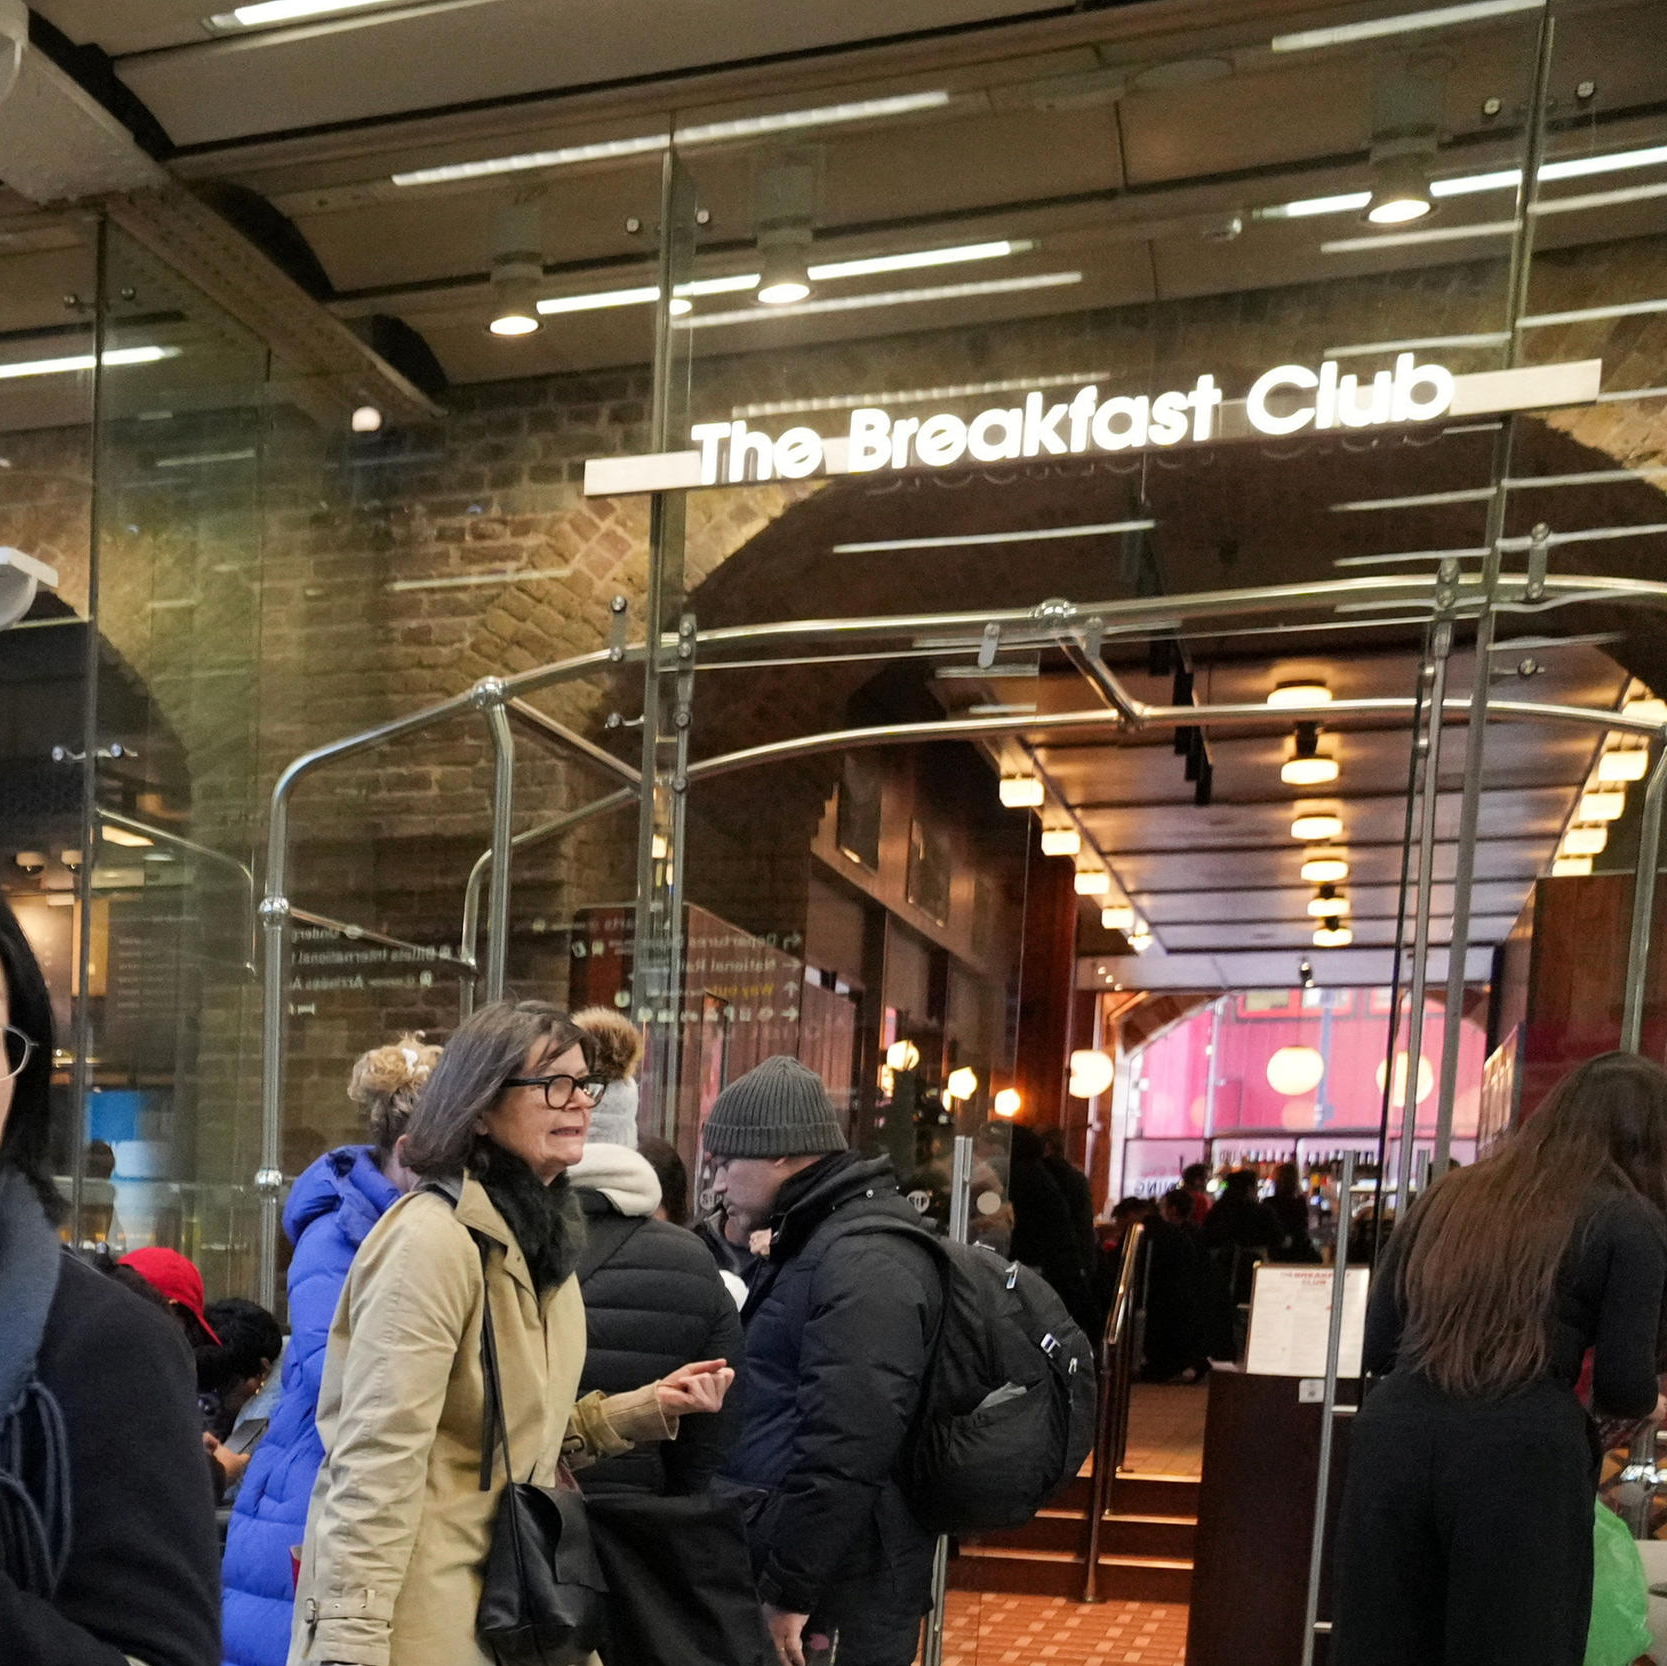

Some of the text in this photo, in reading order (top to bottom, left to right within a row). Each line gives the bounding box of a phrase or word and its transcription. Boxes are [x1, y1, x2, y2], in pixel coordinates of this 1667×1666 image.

[691, 352, 1455, 485] The Breakfast Club
